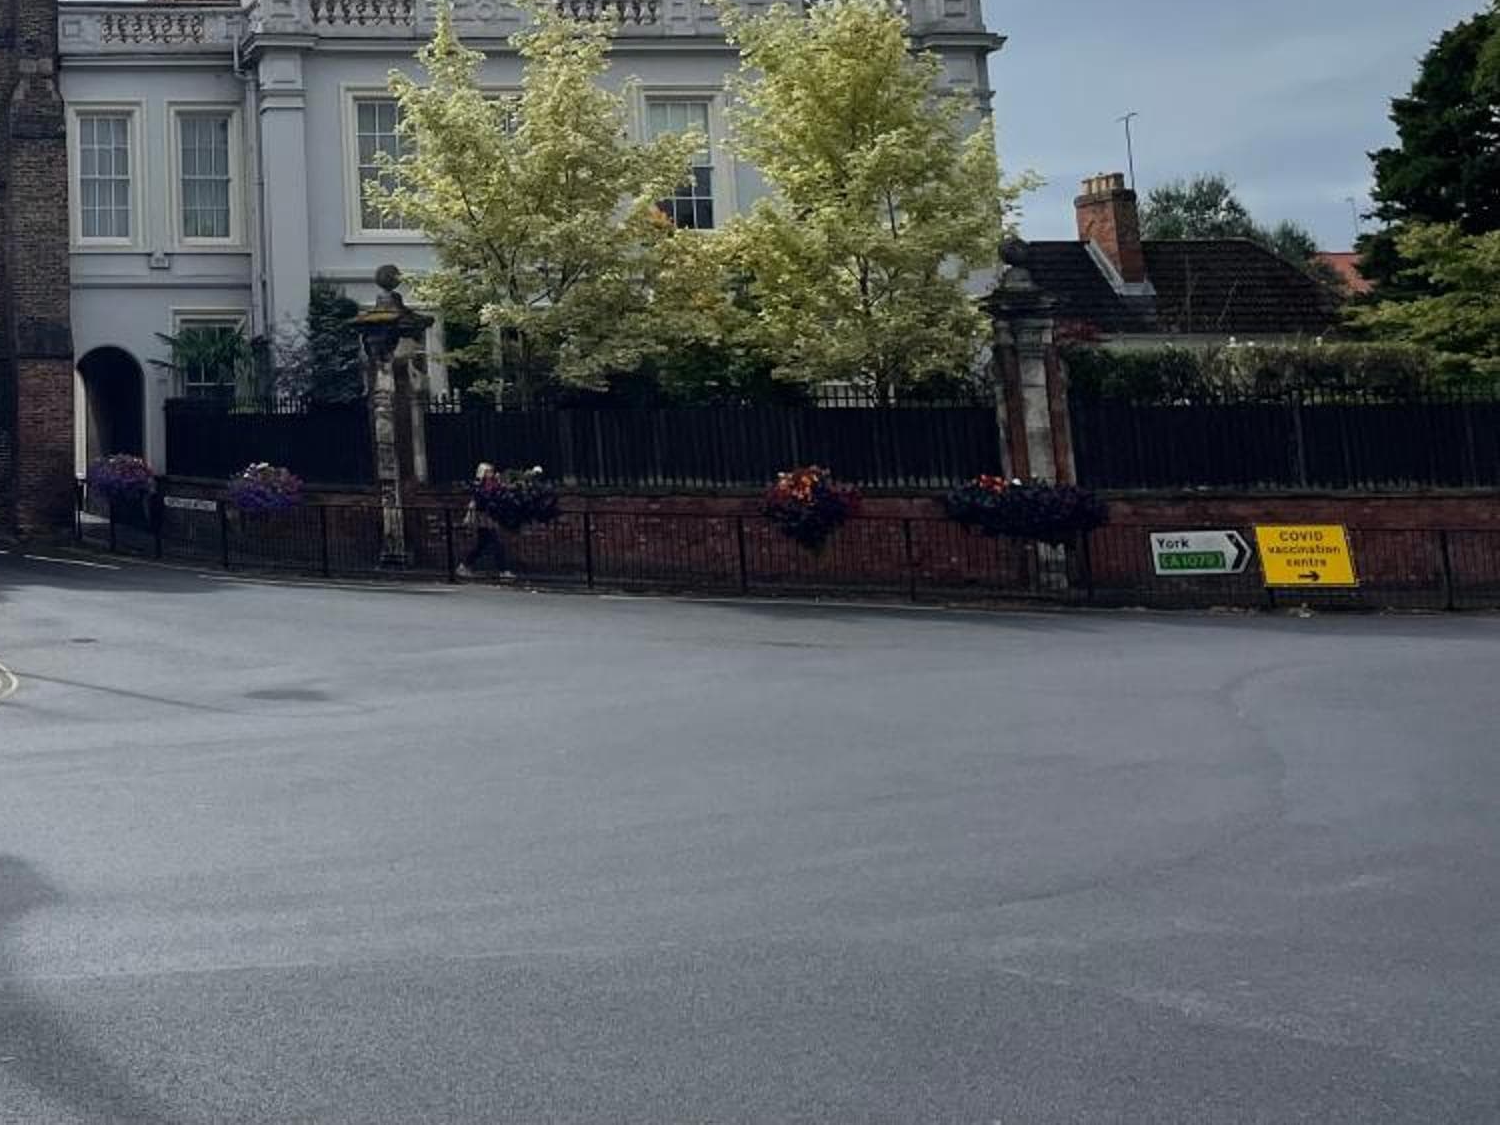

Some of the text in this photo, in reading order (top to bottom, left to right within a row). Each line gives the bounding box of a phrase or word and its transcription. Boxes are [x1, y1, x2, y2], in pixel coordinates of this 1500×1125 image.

[1279, 530, 1324, 542] COVID
[1156, 537, 1190, 550] York
[1267, 544, 1341, 555] vaccination
[1286, 557, 1328, 568] centre
